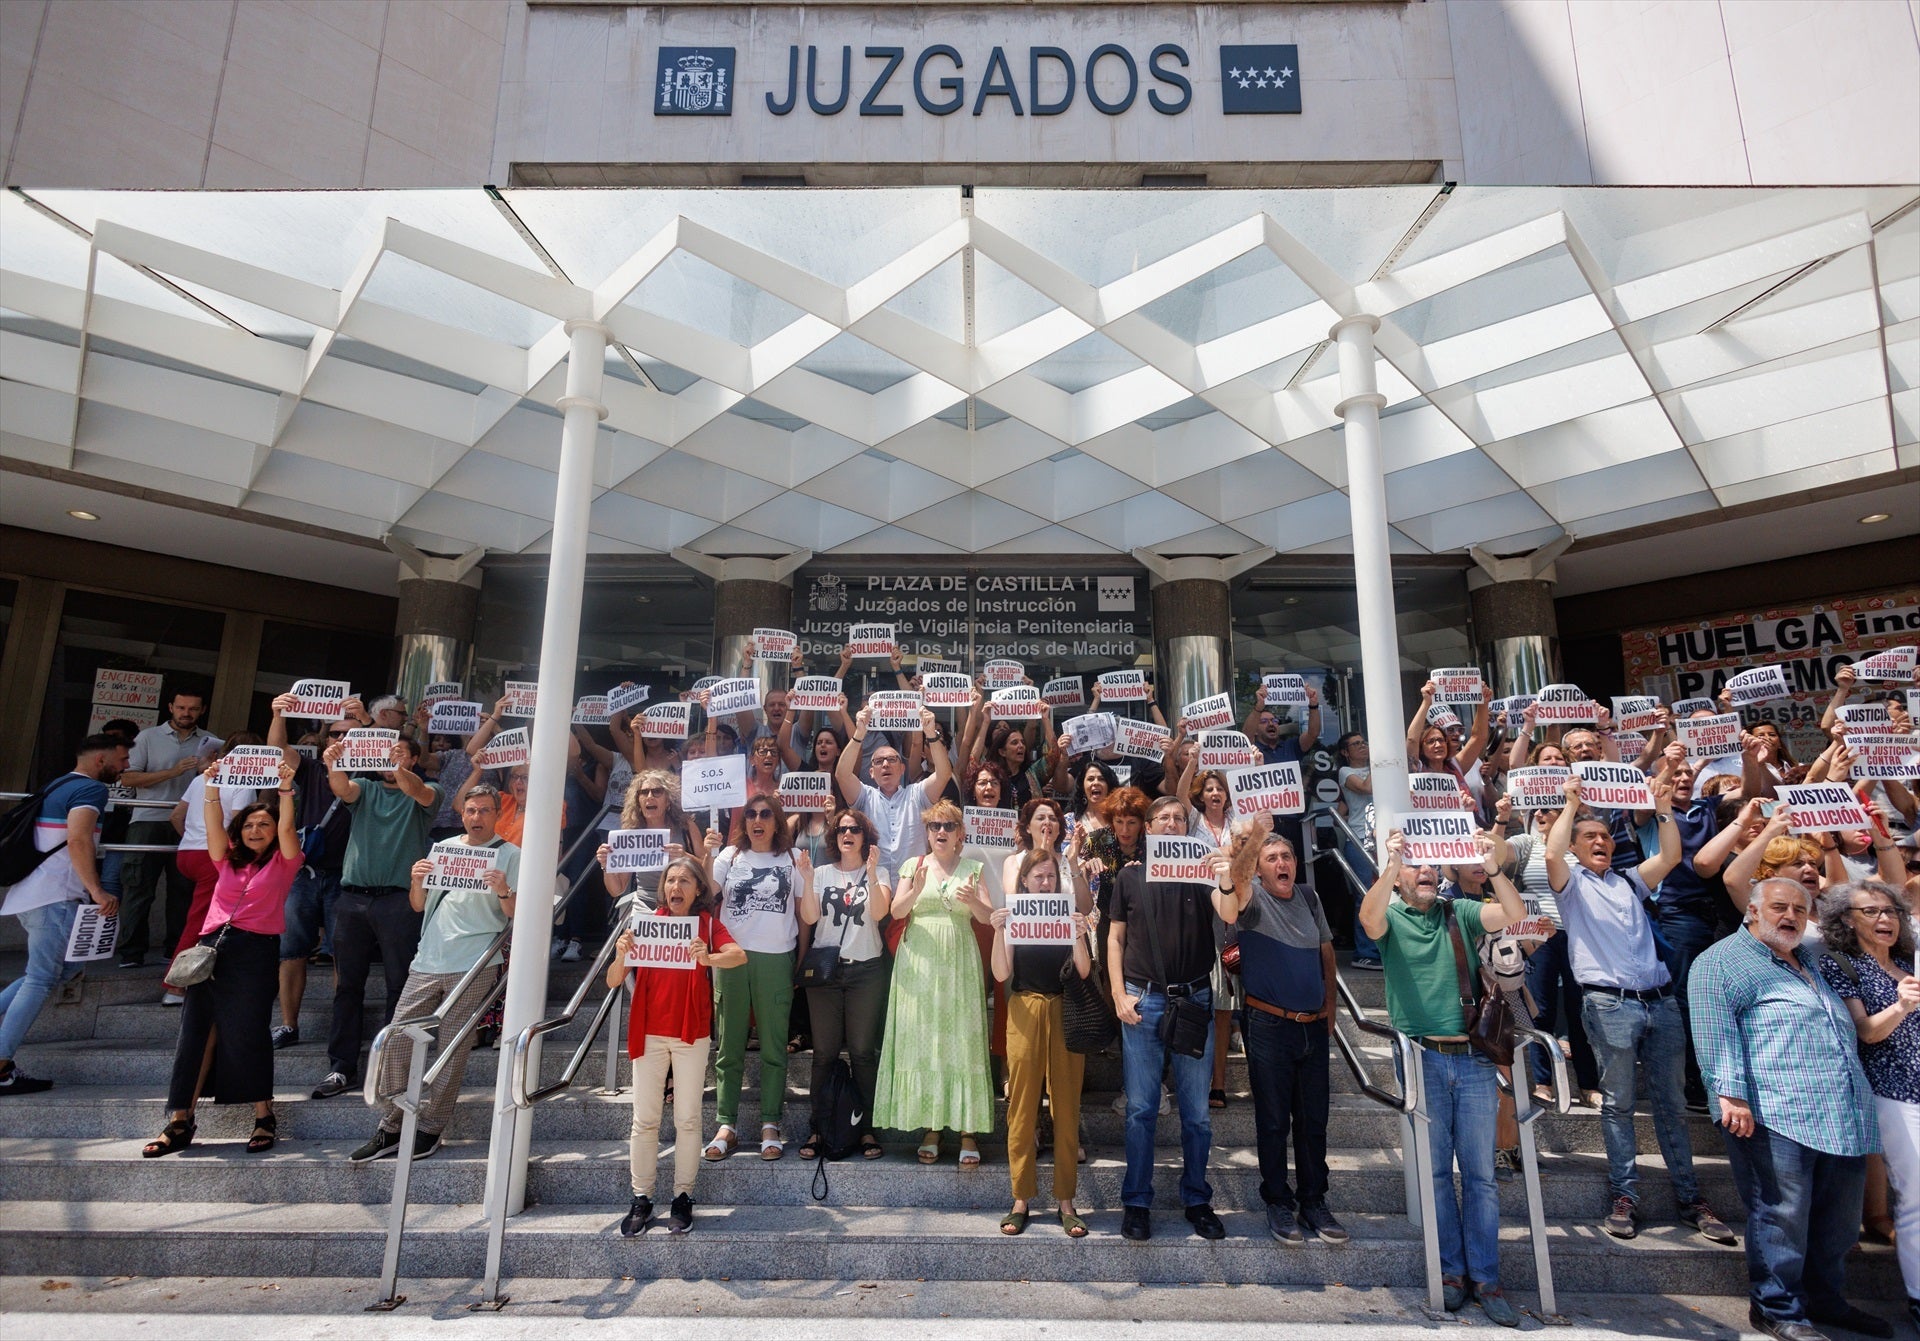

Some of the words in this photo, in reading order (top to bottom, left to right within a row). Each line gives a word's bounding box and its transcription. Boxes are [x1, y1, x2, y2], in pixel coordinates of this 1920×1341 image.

[765, 43, 1193, 118] JUZGADOS
[868, 577, 933, 591] PLAZA
[941, 577, 967, 591] DE
[976, 576, 1074, 591] CASTILLA
[1081, 576, 1089, 590] 1
[854, 598, 941, 613] Juzgados
[946, 598, 967, 613] de
[975, 597, 1076, 613] Instrucción
[853, 628, 891, 639] JUSTICIA
[893, 619, 913, 634] de
[918, 619, 1012, 637] Vigilancia
[1018, 620, 1134, 634] Penitenciaria
[767, 638, 792, 646] JUSTICIA
[1658, 613, 1842, 666] HUELGA
[851, 641, 892, 653] SOLUCIÓN
[916, 641, 944, 655] los
[949, 642, 1030, 660] Juzgados
[1036, 642, 1057, 655] de
[1063, 641, 1134, 655] Madrid
[101, 671, 157, 685] ENCIERRO
[1103, 673, 1141, 684] JUSTICIA
[1730, 669, 1777, 688] JUSTICIA
[1865, 669, 1912, 678] CLASISMO
[798, 679, 838, 692] JUSTICIA
[927, 676, 968, 688] JUSTICIA
[1045, 680, 1078, 692] JUSTICIA
[1267, 677, 1304, 688] JUSTICIA
[1449, 677, 1478, 685] JUSTICIA
[294, 684, 342, 698] JUSTICIA
[426, 685, 458, 695] JUSTICIA
[712, 679, 754, 697] JUSTICIA
[1103, 686, 1143, 698] SOLUCIÓN
[1732, 683, 1784, 702] SOLUCIÓN
[146, 695, 157, 704] YA
[609, 690, 645, 711] SOLUCIÓN
[794, 694, 837, 707] SOLUCIÓN
[926, 690, 970, 702] SOLUCIÓN
[1044, 693, 1080, 704] SOLUCIÓN
[1267, 689, 1306, 702] SOLUCIÓN
[1435, 693, 1443, 702] EL
[1445, 693, 1482, 701] CLASISMO
[286, 701, 341, 715] SOLUCIÓN
[710, 693, 756, 712] SOLUCIÓN
[874, 701, 882, 709] EN
[886, 701, 916, 709] JUSTICIA
[994, 702, 1038, 715] SOLUCIÓN
[1186, 698, 1225, 716] JUSTICIA
[1677, 701, 1712, 714] JUSTICIA
[435, 706, 476, 717] JUSTICIA
[645, 707, 685, 719] JUSTICIA
[880, 709, 907, 717] CONTRA
[1537, 704, 1593, 719] SOLUCIÓN
[1845, 709, 1890, 722] JUSTICIA
[432, 719, 475, 731] SOLUCIÓN
[868, 719, 877, 727] EL
[880, 718, 920, 728] CLASISMO
[1188, 711, 1230, 731] SOLUCIÓN
[1720, 715, 1738, 724] HUELGA
[641, 720, 685, 735] SOLUCIÓN
[1125, 728, 1133, 736] EN
[1688, 729, 1698, 738] EN
[1701, 725, 1736, 736] JUSTICIA
[343, 740, 352, 748] EN
[355, 739, 392, 748] JUSTICIA
[487, 733, 525, 749] JUSTICIA
[1129, 737, 1153, 748] CONTRA
[1203, 735, 1248, 748] JUSTICIA
[1696, 736, 1727, 747] CONTRA
[261, 748, 282, 756] HUELGA
[350, 748, 382, 757] CONTRA
[483, 747, 526, 765] SOLUCIÓN
[1117, 743, 1125, 752] EL
[1128, 745, 1163, 759] CLASISMO
[1685, 748, 1693, 757] EL
[1697, 742, 1743, 756] CLASISMO
[1859, 746, 1871, 755] EN
[1873, 746, 1912, 756] JUSTICIA
[224, 757, 234, 765] EN
[238, 756, 276, 767] JUSTICIA
[336, 758, 346, 767] EL
[1202, 750, 1251, 765] SOLUCIÓN
[1867, 756, 1902, 765] CONTRA
[230, 766, 264, 775] CONTRA
[701, 769, 723, 778] S.O.S
[1582, 766, 1644, 784] JUSTICIA
[1854, 766, 1865, 776] EL
[213, 776, 222, 784] EL
[228, 776, 279, 786] CLASISMO
[782, 776, 825, 790] JUSTICIA
[1235, 767, 1296, 792] JUSTICIA
[1413, 778, 1457, 792] JUSTICIA
[1515, 778, 1525, 786] EN
[1528, 778, 1565, 786] JUSTICIA
[693, 782, 731, 793] JUSTICIA
[1523, 786, 1556, 795] CONTRA
[779, 793, 826, 808] SOLUCIÓN
[1238, 787, 1300, 814] SOLUCIÓN
[1412, 793, 1460, 809] SOLUCIÓN
[1511, 797, 1521, 806] EL
[1581, 786, 1648, 804] SOLUCIÓN
[1788, 787, 1852, 806] JUSTICIA
[966, 808, 974, 816] DOS
[975, 809, 992, 817] MESES
[1000, 811, 1016, 819] HUELGA
[1792, 805, 1864, 828] SOLUCIÓN
[971, 818, 980, 826] EN
[982, 818, 1012, 829] JUSTICIA
[1403, 818, 1470, 836] JUSTICIA
[976, 826, 1003, 836] CONTRA
[613, 834, 663, 850] JUSTICIA
[965, 834, 974, 844] EL
[976, 835, 1015, 848] CLASISMO
[434, 845, 444, 853] DOS
[446, 846, 464, 855] MESES
[465, 848, 472, 856] EN
[474, 849, 495, 858] HUELGA
[1404, 839, 1476, 859] SOLUCIÓN
[438, 855, 448, 865] EN
[451, 856, 487, 868] JUSTICIA
[610, 850, 664, 868] SOLUCIÓN
[443, 866, 475, 878] CONTRA
[1151, 862, 1216, 880] SOLUCIÓN
[427, 874, 437, 885] EL
[1012, 899, 1069, 917] JUSTICIA
[72, 908, 97, 957] SOLUCIÓN
[634, 920, 691, 939] JUSTICIA
[1010, 919, 1071, 939] SOLUCIÓN
[629, 942, 691, 964] SOLUCIÓN
